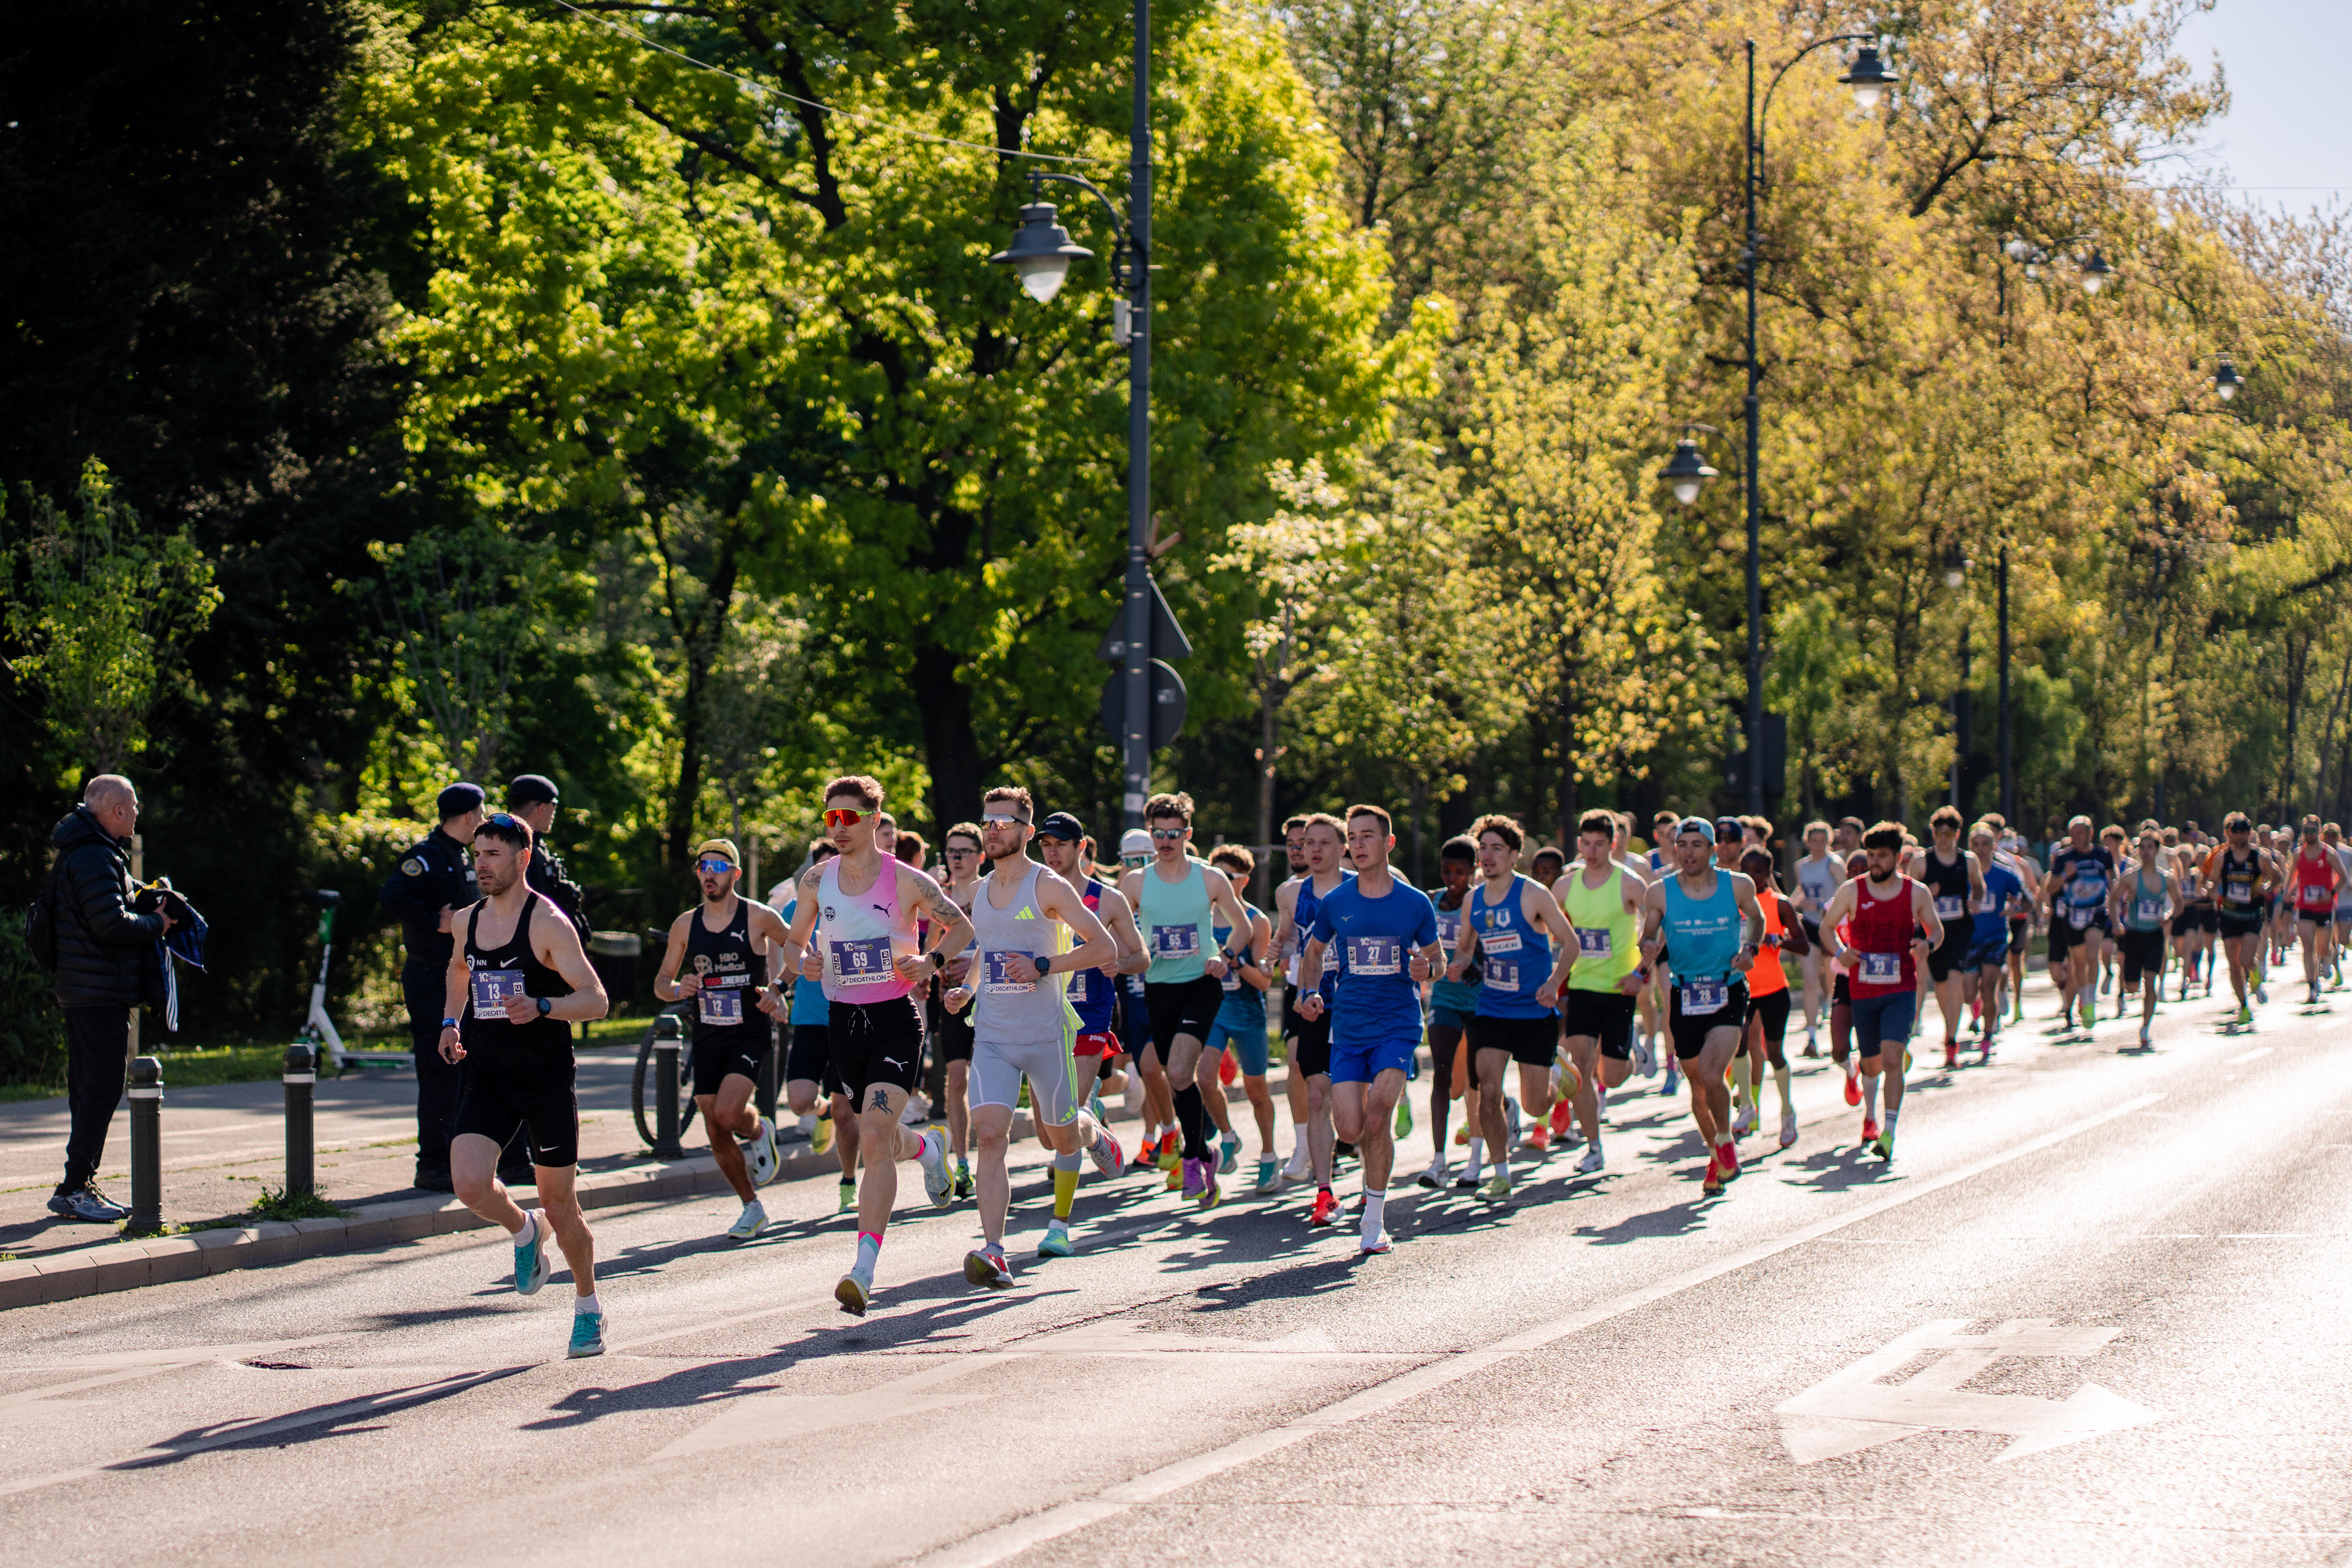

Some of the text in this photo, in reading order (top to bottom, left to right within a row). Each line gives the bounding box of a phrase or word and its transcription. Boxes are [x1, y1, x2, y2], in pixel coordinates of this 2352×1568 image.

[1169, 934, 1181, 945] 65
[719, 952, 739, 962] HBO
[852, 951, 867, 967] 69
[1368, 946, 1380, 960] 27
[714, 961, 745, 972] Medical
[849, 975, 886, 983] DECATHLON
[487, 983, 500, 1000] 13
[1699, 989, 1711, 1001] 28
[712, 1000, 722, 1012] 12
